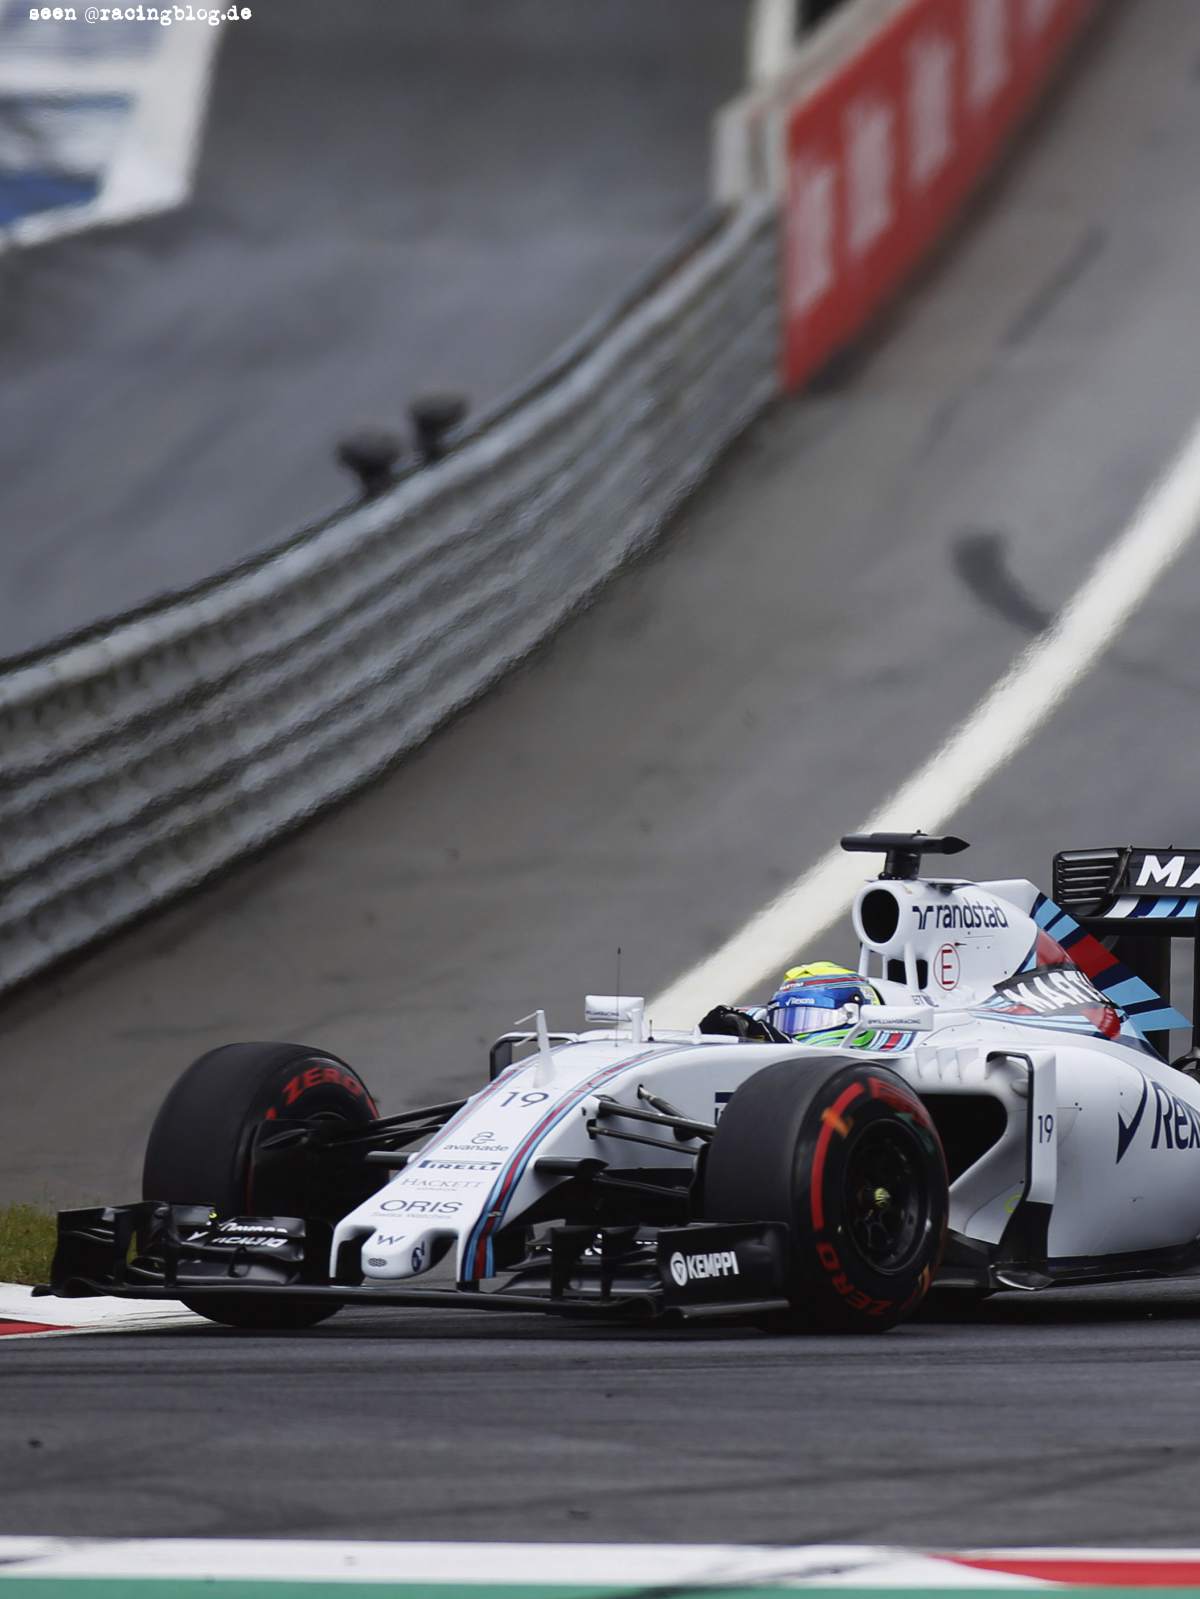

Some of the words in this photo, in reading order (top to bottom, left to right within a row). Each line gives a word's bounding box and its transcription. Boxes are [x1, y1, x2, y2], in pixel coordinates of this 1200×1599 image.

[936, 897, 1009, 928] randstad
[282, 1067, 363, 1104] ZERO
[500, 1091, 549, 1107] 19
[1038, 1114, 1054, 1143] 19
[443, 1144, 509, 1152] avanade
[418, 1160, 502, 1171] PIRELLI
[401, 1178, 482, 1189] HACKETT
[380, 1200, 463, 1213] ORIS
[686, 1250, 740, 1279] KEMPPI
